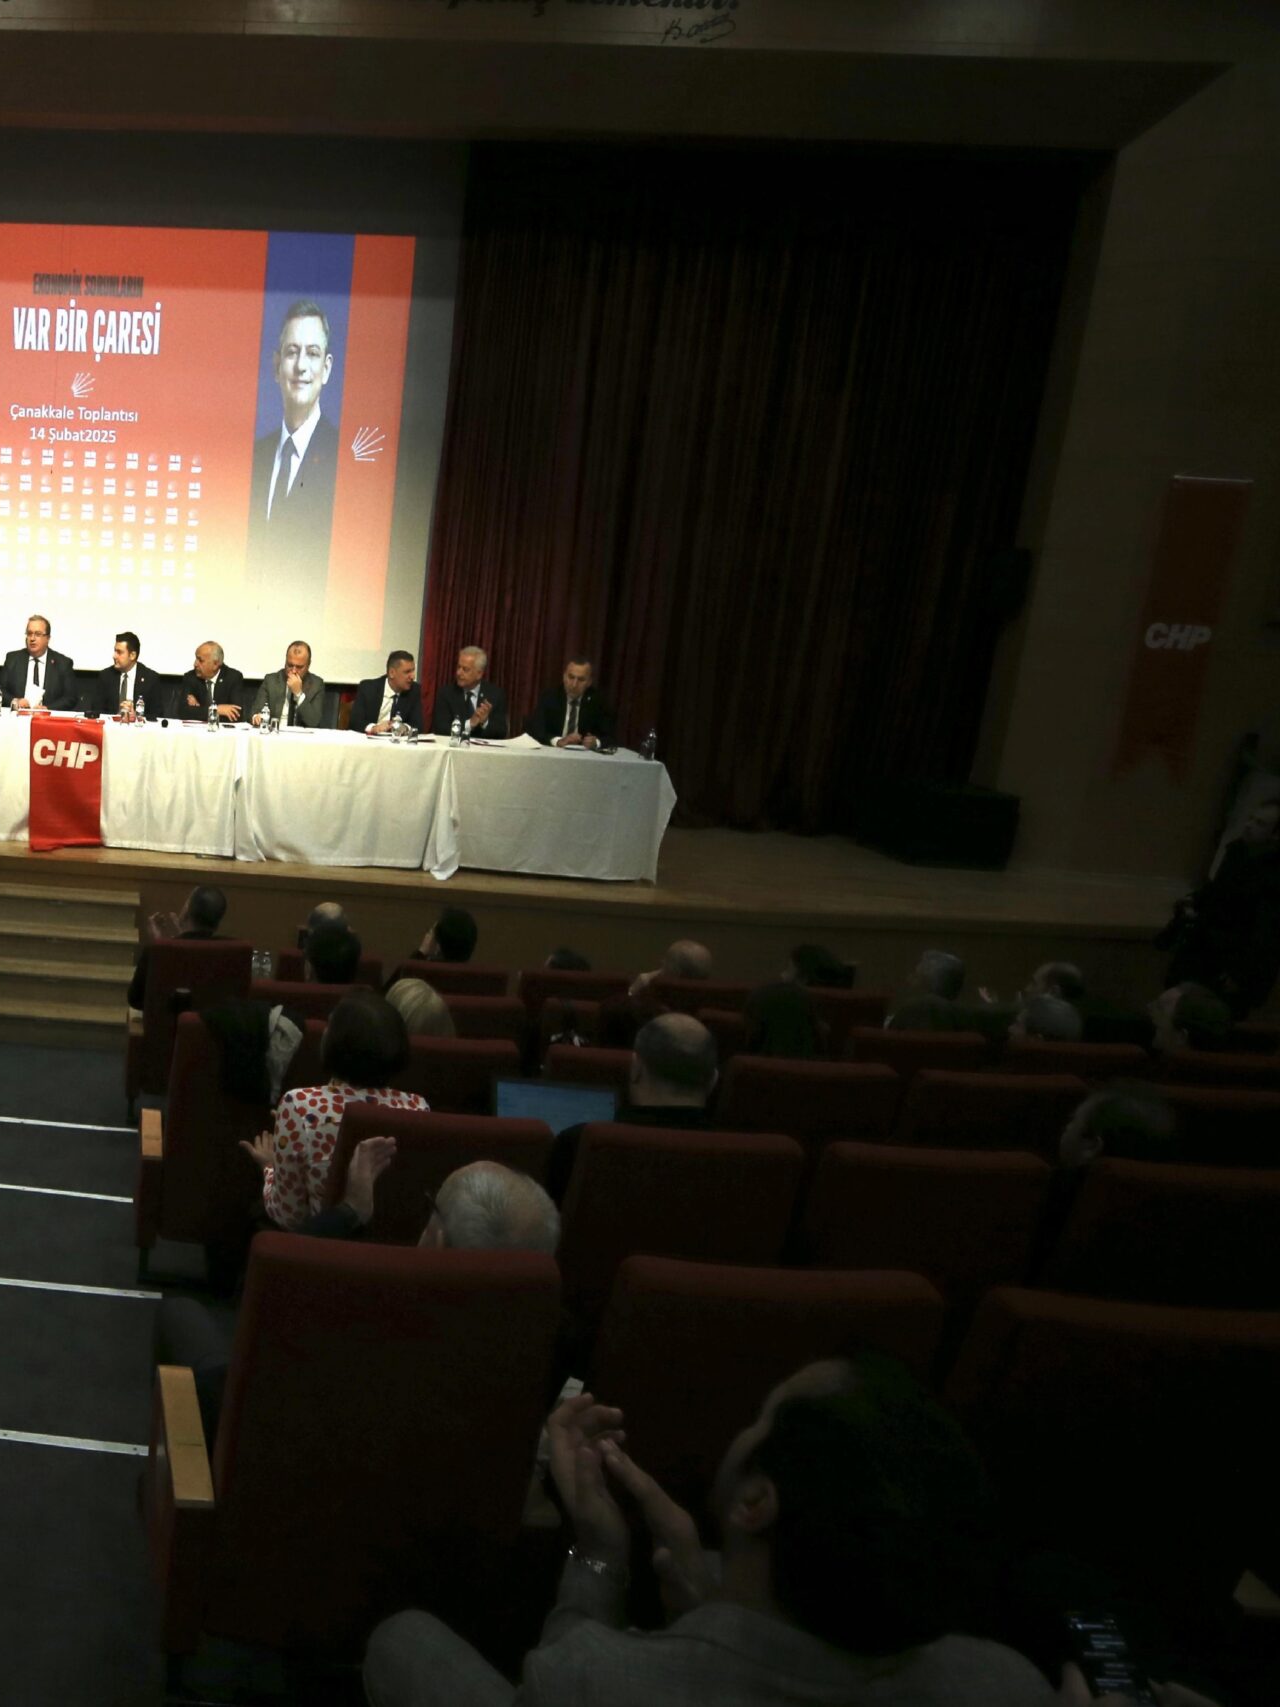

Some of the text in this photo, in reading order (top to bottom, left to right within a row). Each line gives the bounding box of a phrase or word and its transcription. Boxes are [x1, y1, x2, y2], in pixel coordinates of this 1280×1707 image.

[13, 299, 162, 362] VAR BİR ÇARESİ
[10, 404, 138, 423] Çanakkale Toplantısı
[29, 427, 45, 440] 14
[1144, 622, 1212, 651] CHP
[32, 738, 100, 770] CHP
